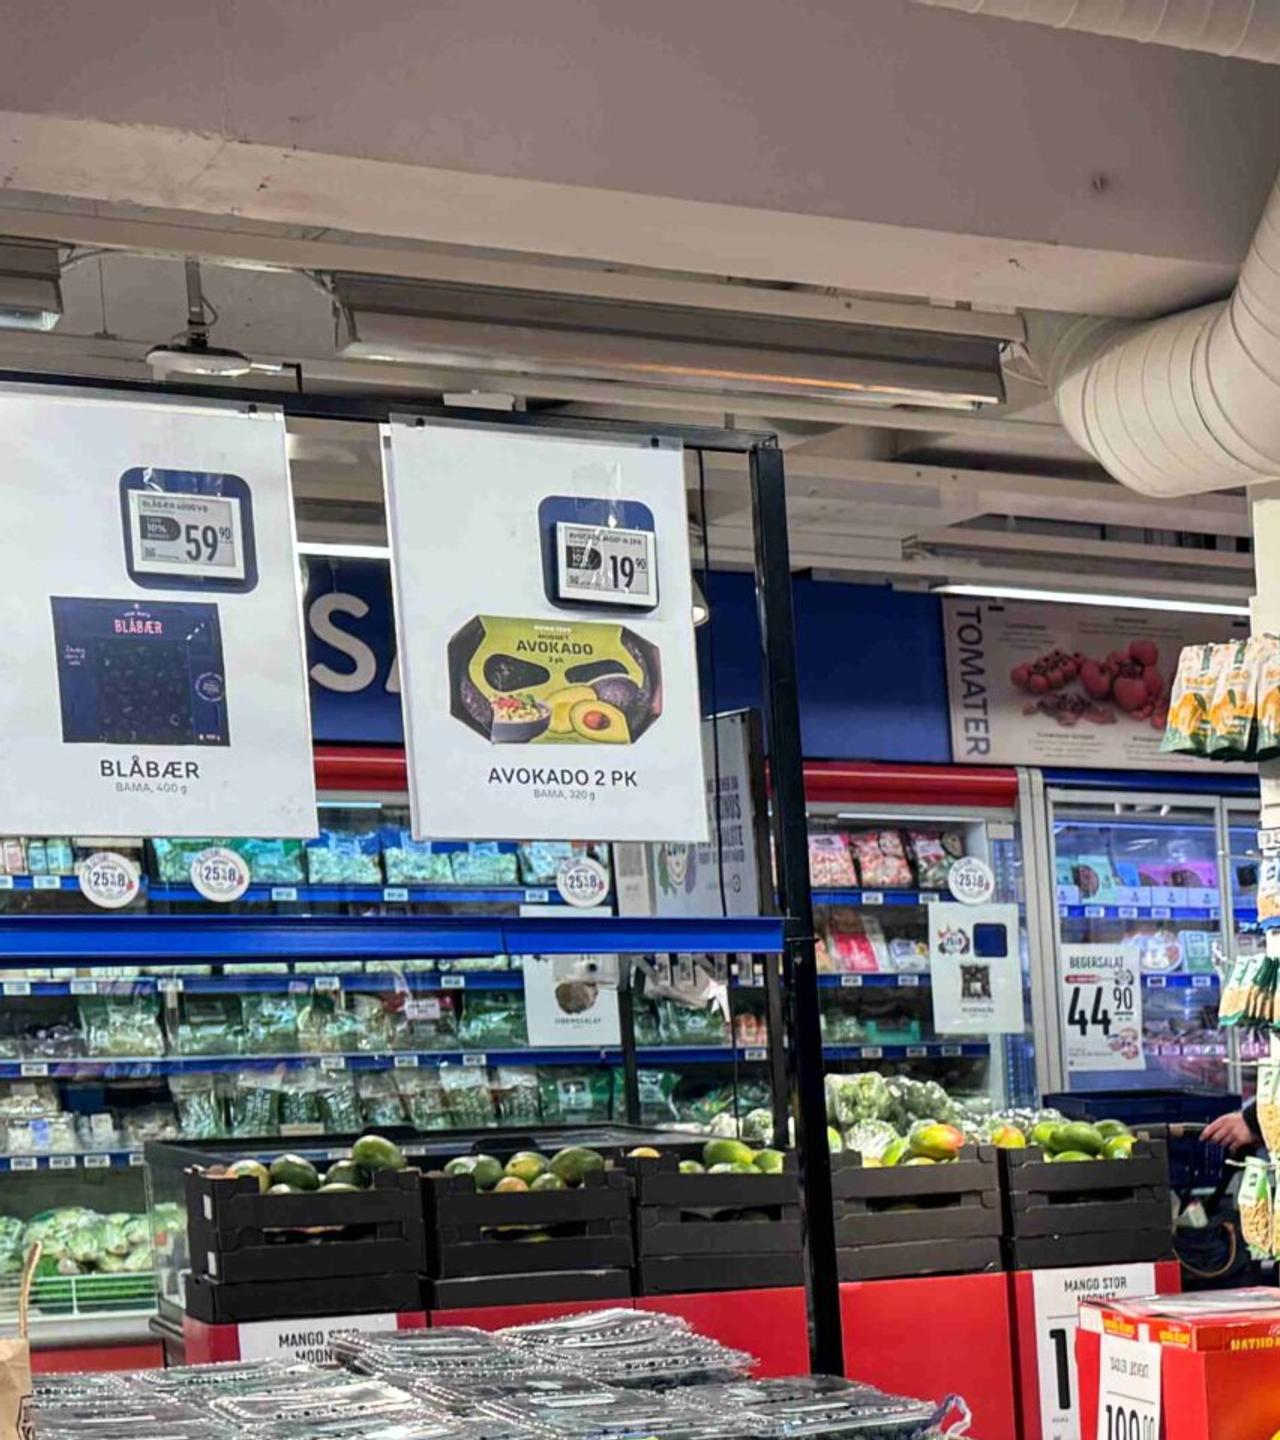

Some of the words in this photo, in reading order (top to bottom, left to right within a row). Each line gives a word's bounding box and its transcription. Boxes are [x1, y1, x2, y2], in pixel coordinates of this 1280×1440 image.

[185, 524, 219, 562] 59
[219, 527, 231, 540] 90
[610, 555, 635, 589] 19
[636, 558, 647, 569] 90
[114, 616, 163, 635] BLÅBÆR
[516, 640, 593, 656] AVOKADO
[956, 606, 990, 756] TOMATER
[100, 755, 200, 779] BLÅBÆR
[488, 768, 590, 786] AVOKADO
[594, 769, 606, 786] 2
[611, 770, 638, 787] PK
[116, 782, 154, 794] BAMA,
[156, 783, 178, 794] 400
[180, 785, 188, 796] g
[533, 789, 567, 801] BAMA,
[569, 790, 588, 800] 320
[589, 791, 596, 802] g
[1067, 986, 1112, 1036] 44
[1113, 986, 1133, 1010] 90
[1064, 1278, 1101, 1293] MANGO
[1103, 1277, 1127, 1290] STOR
[279, 1332, 325, 1349] MANGO
[1050, 1328, 1071, 1410] 1
